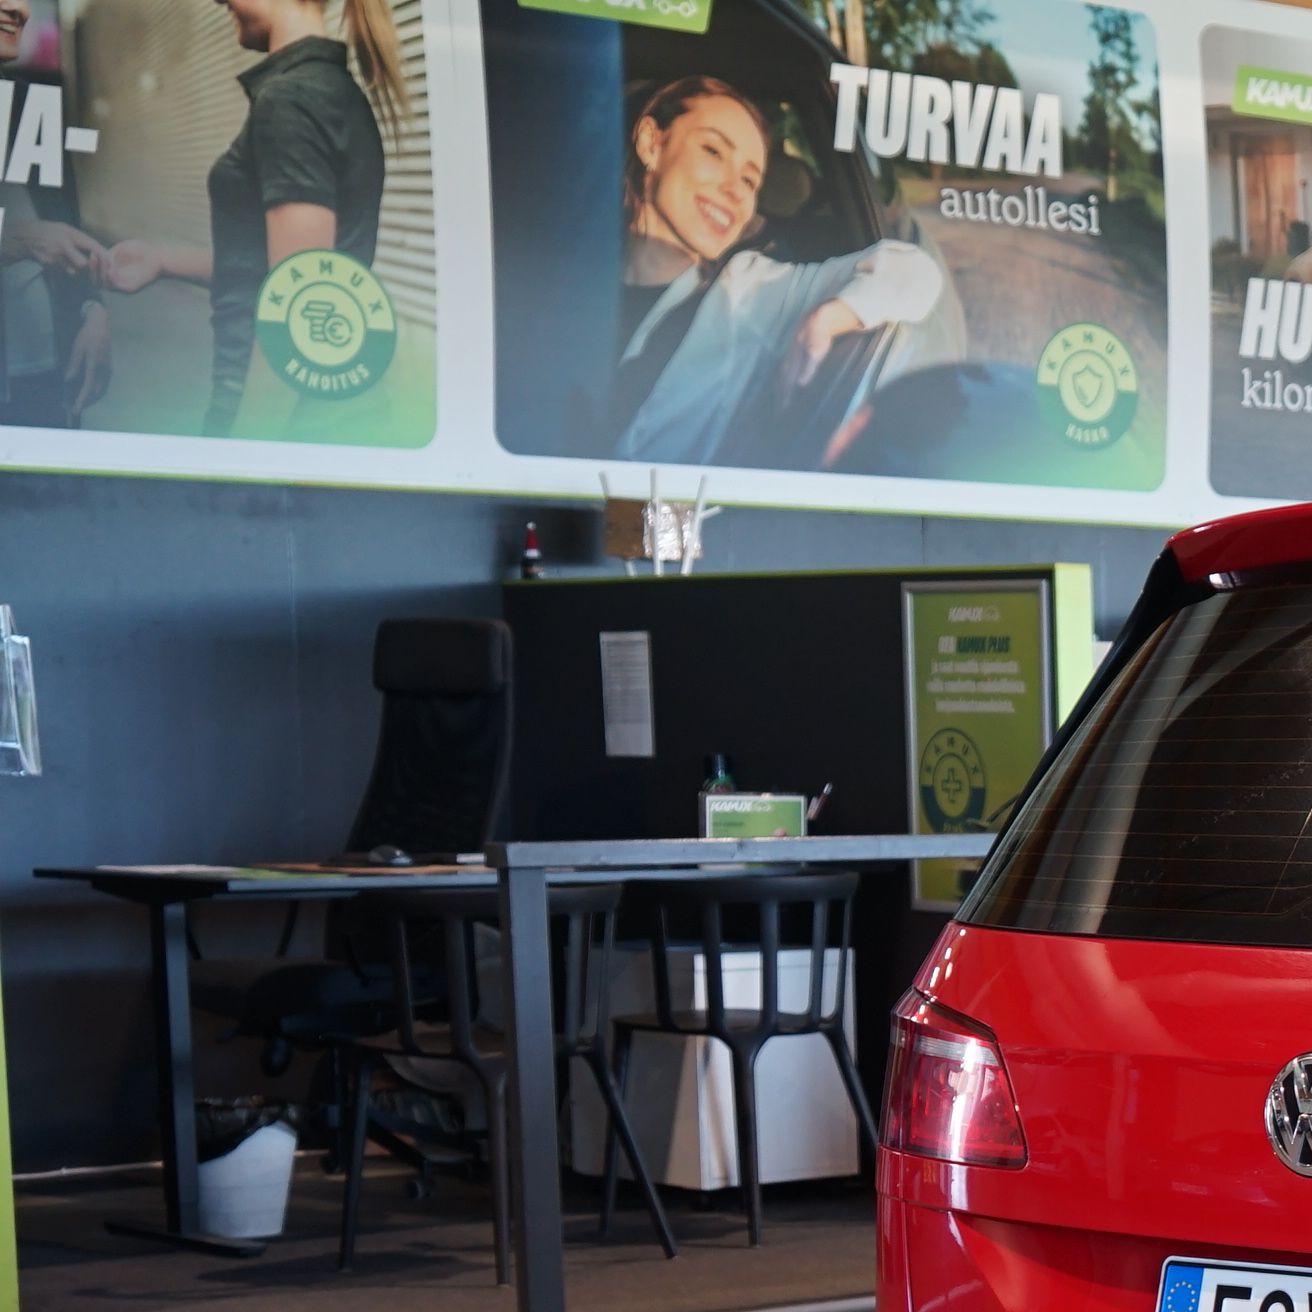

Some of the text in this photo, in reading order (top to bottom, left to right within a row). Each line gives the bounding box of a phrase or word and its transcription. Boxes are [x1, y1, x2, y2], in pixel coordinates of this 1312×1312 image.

[0, 79, 99, 187] A-
[830, 62, 1064, 179] TURVAA
[939, 184, 1102, 236] autollesi
[267, 259, 383, 314] KAMUX
[284, 358, 370, 391] RAHOITUS
[1045, 330, 1130, 377] KAMUX
